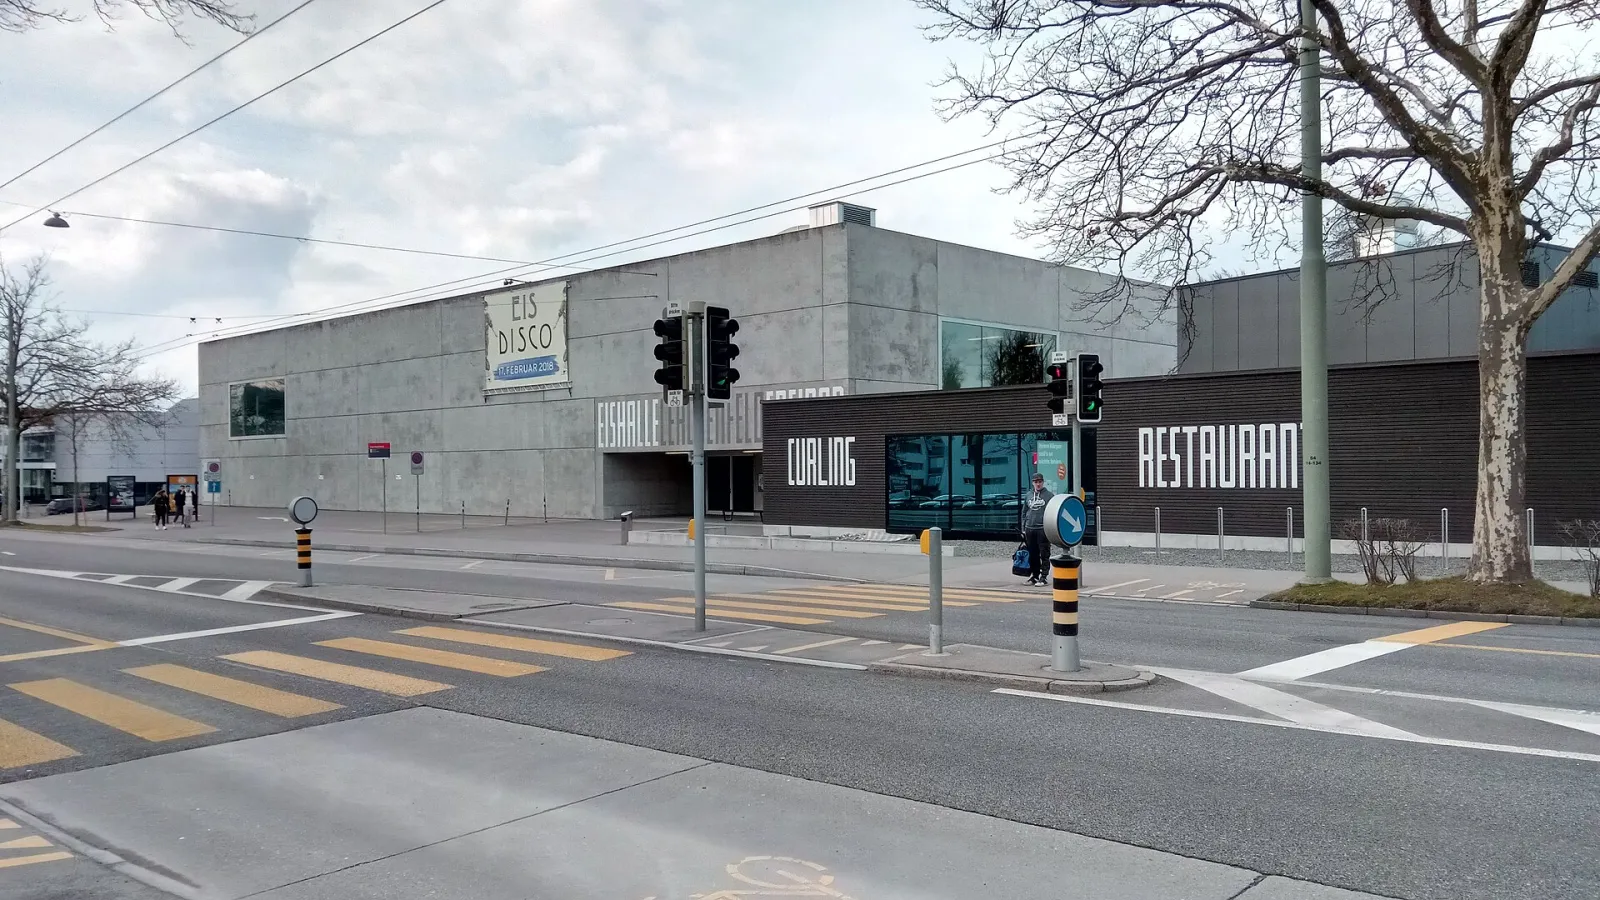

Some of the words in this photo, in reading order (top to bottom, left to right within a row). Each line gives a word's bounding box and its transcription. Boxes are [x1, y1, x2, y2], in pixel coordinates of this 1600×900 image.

[511, 292, 538, 321] EIS
[499, 323, 552, 354] DISCO
[506, 363, 538, 375] FEBRUAR
[538, 361, 554, 371] 2018
[597, 398, 659, 448] EISHALLE
[660, 391, 764, 447] LERCENFELD
[787, 436, 856, 486] CURLING
[1138, 422, 1303, 488] RESTAURAN
